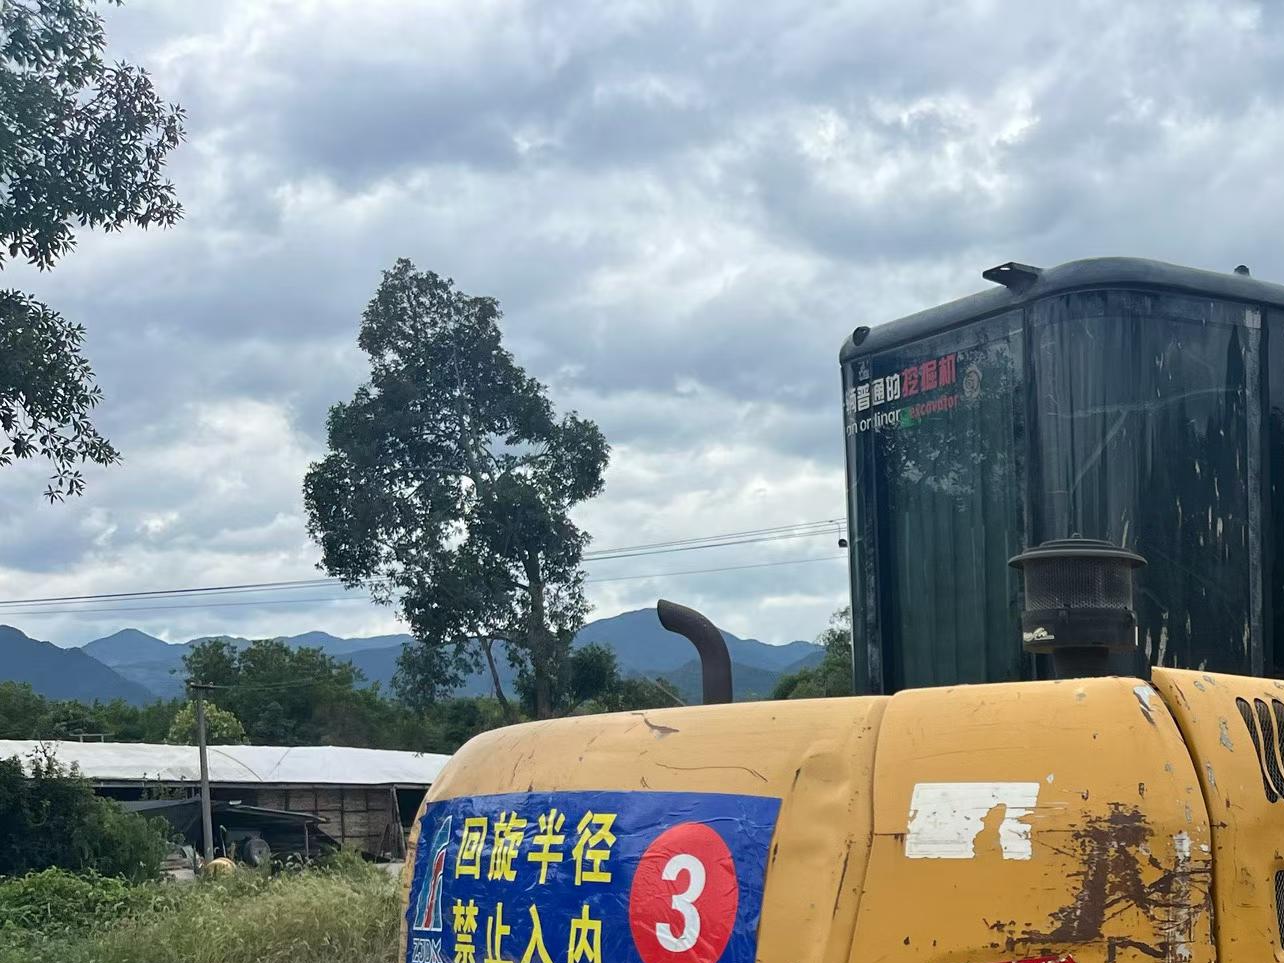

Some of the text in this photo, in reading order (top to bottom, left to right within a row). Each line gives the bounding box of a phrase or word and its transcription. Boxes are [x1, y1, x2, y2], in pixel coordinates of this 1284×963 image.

[454, 809, 618, 887] 回旋半径
[655, 854, 707, 952] 3
